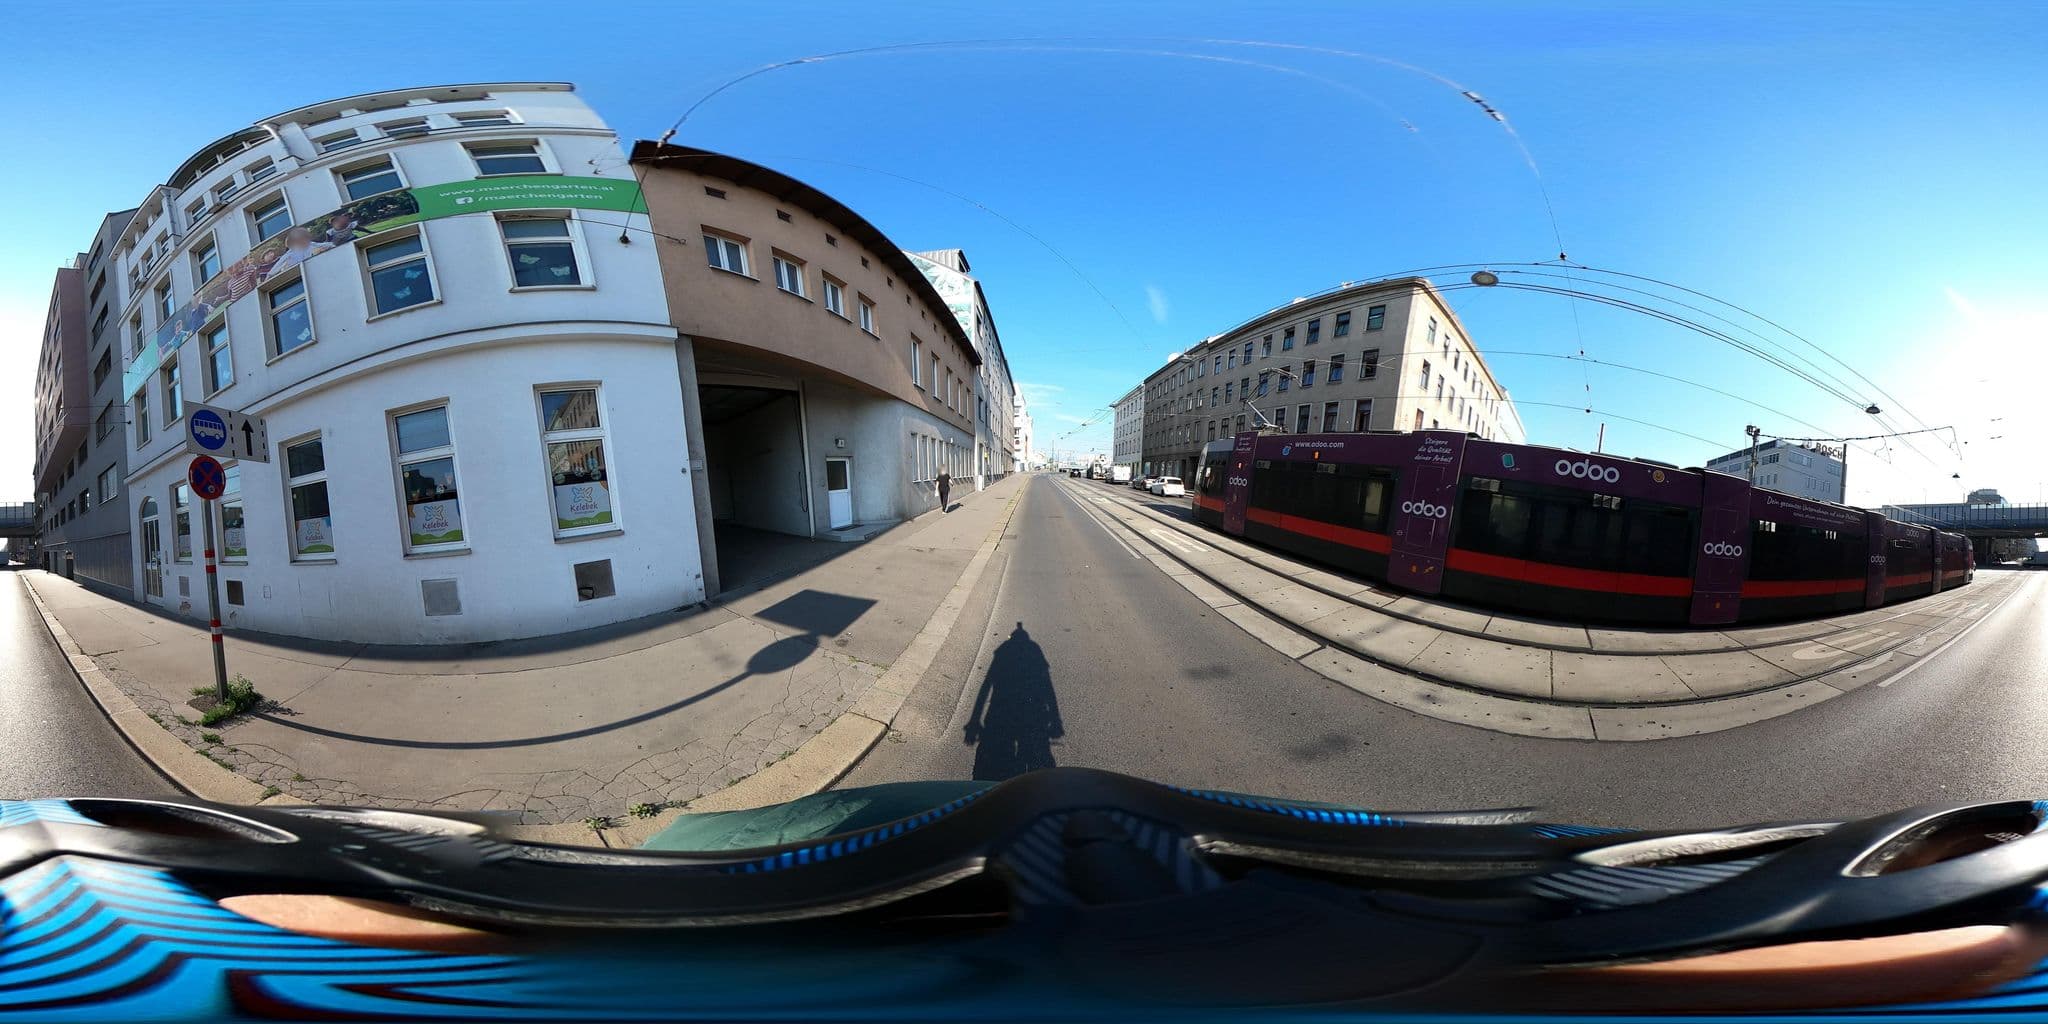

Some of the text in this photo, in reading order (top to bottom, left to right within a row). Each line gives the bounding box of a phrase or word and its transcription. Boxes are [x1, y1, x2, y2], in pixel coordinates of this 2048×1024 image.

[439, 184, 614, 197] www.maerchengarten.at
[477, 192, 603, 202] /maerchengarten
[1295, 440, 1345, 449] www.odoo.com
[1816, 442, 1843, 460] BOSCH
[1555, 458, 1620, 484] odoo
[1228, 475, 1248, 487] odoo
[569, 502, 599, 513] Kelebek
[1402, 500, 1447, 518] odoo
[422, 520, 449, 530] Kelebek
[1703, 541, 1743, 556] odoo
[1870, 554, 1887, 564] odoo
